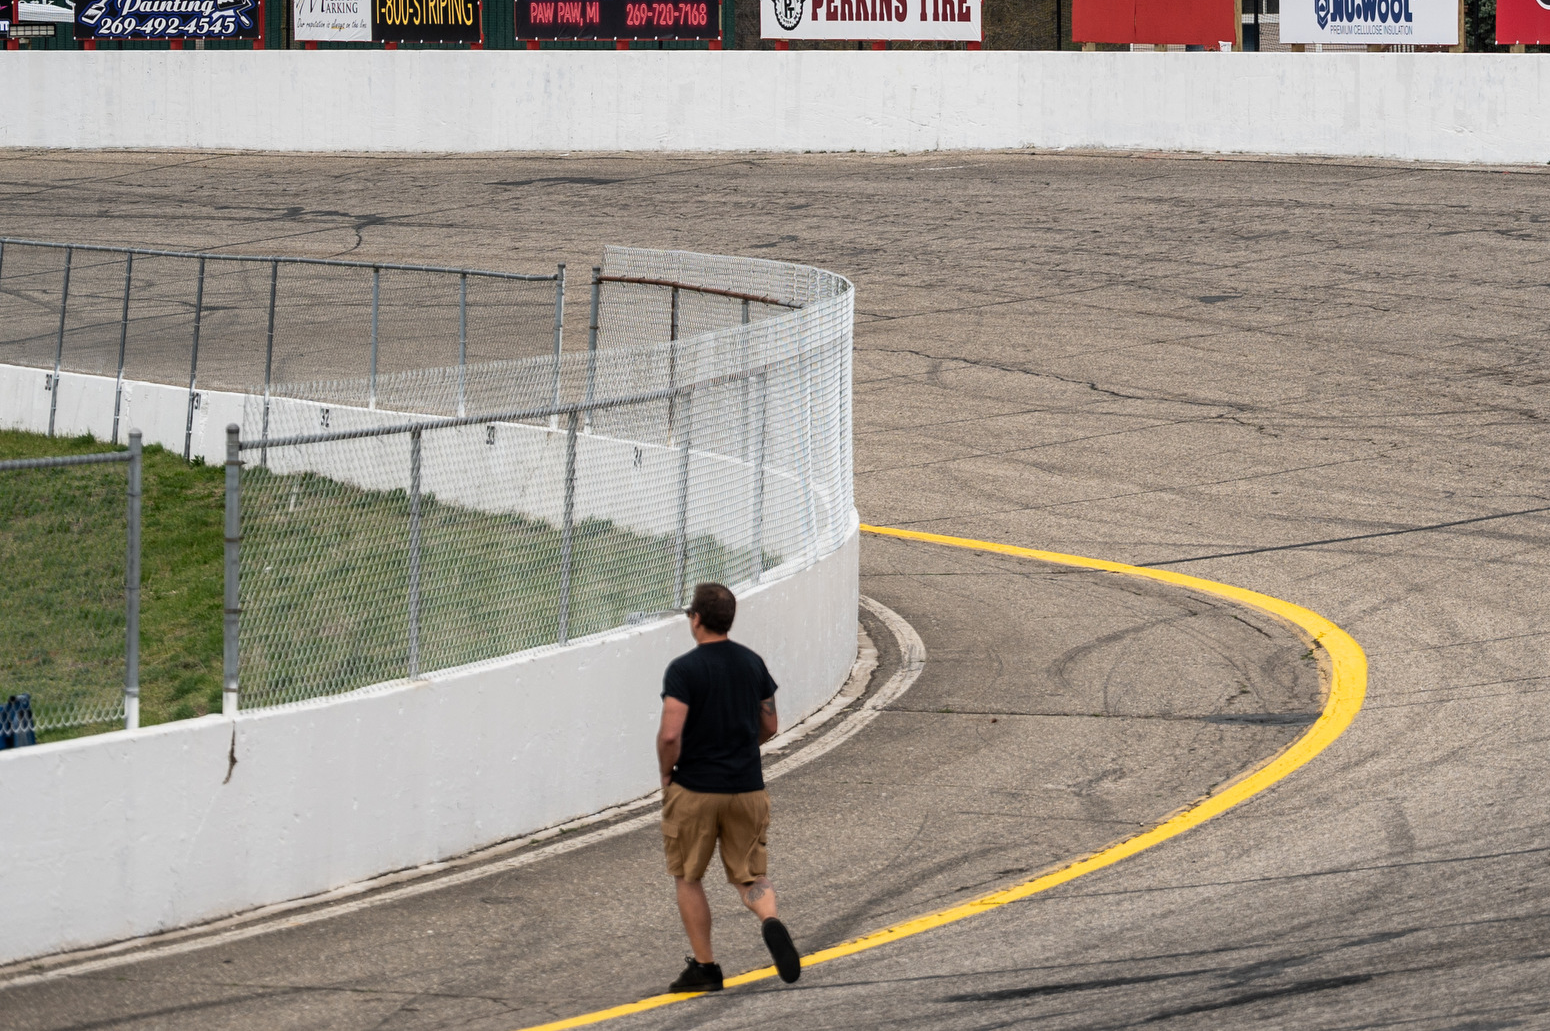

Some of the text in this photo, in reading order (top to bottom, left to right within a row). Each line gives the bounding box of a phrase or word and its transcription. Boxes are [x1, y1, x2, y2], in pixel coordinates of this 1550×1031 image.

[530, 2, 600, 27] PAW PAW, MI
[626, 3, 707, 26] 269-720-7168
[98, 17, 236, 35] 269-492-4545
[1330, 25, 1413, 35] PREMIUM CELLULOSE INSULATION
